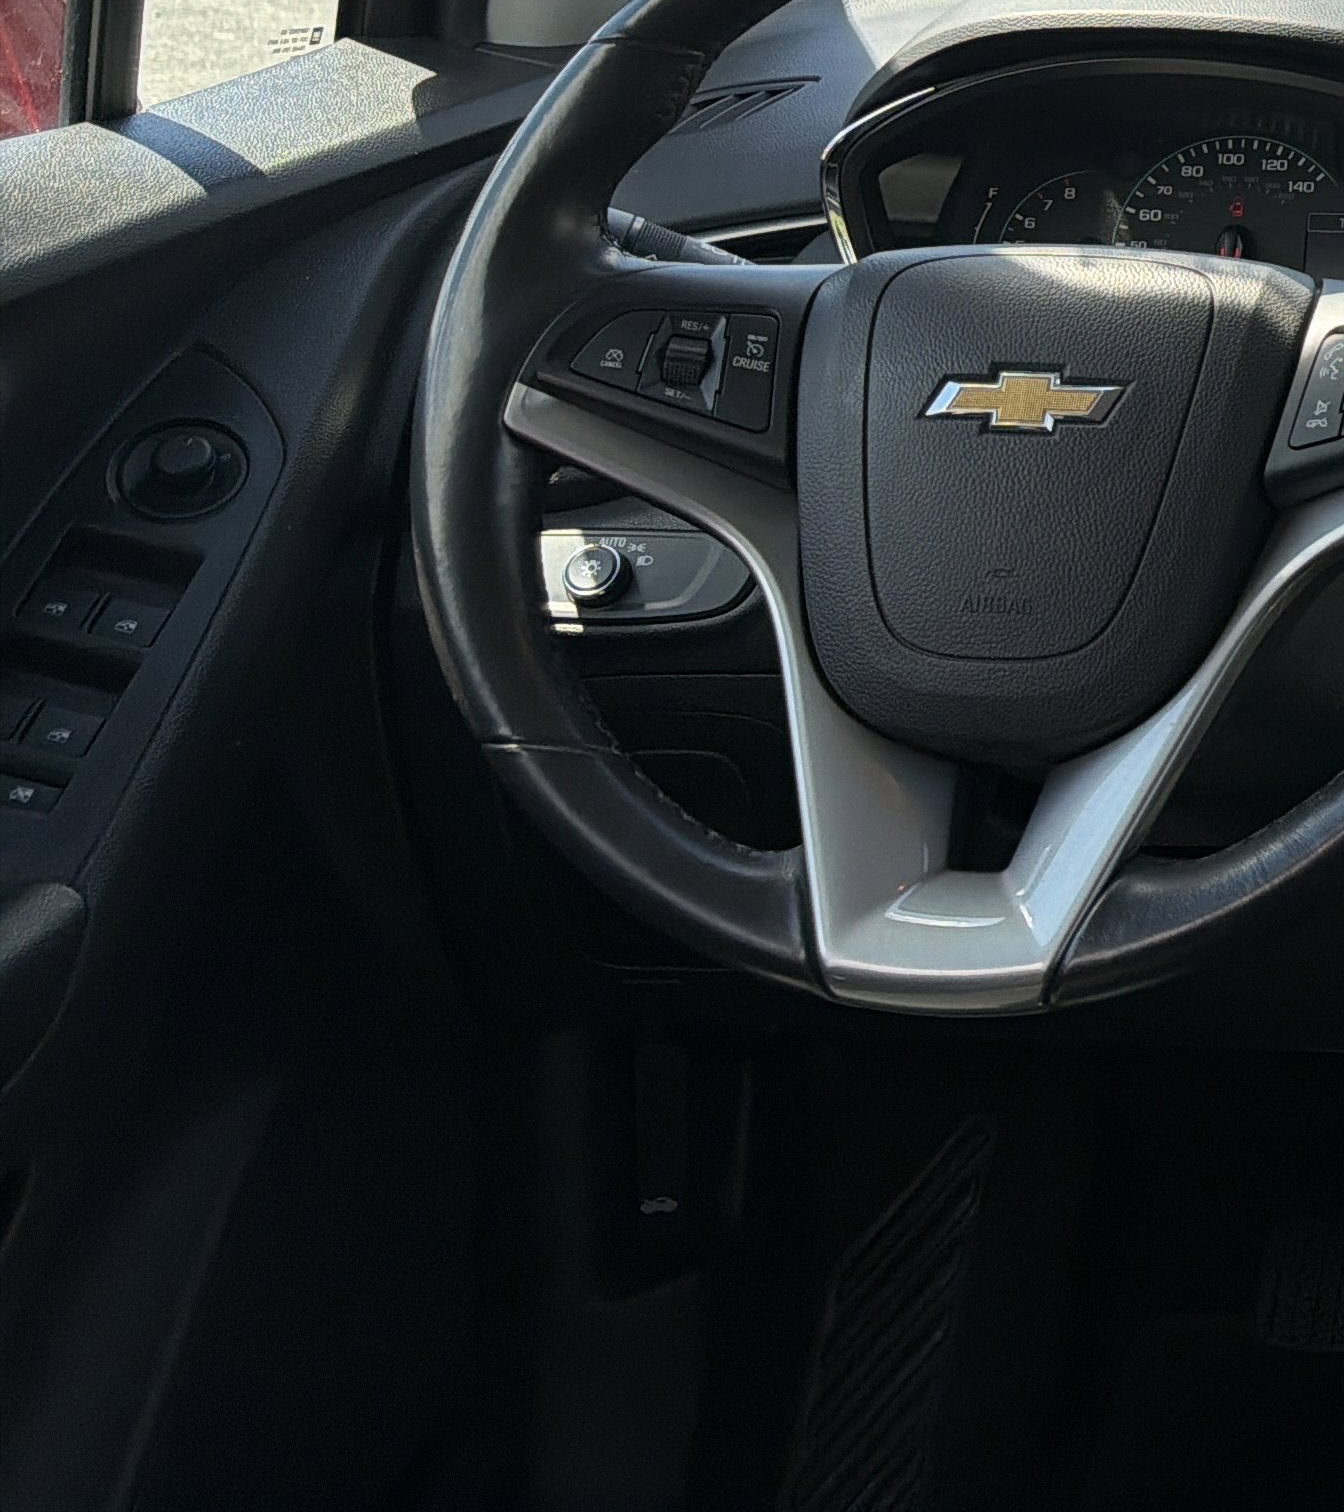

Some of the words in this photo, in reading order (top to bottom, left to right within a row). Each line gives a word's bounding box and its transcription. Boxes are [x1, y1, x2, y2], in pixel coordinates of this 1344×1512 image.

[1217, 153, 1245, 165] 100
[1261, 159, 1288, 171] 120
[1181, 165, 1204, 178] 80
[988, 187, 999, 199] F
[1156, 186, 1173, 195] 70
[1287, 181, 1315, 194] 140
[1064, 188, 1076, 200] 8
[1043, 199, 1054, 212] 7
[1139, 209, 1162, 222] 60
[1024, 217, 1036, 229] 6
[600, 360, 622, 369] CANCEL
[732, 355, 771, 373] CRUISE
[598, 536, 627, 548] AUTO
[961, 594, 1033, 614] AIRBAG
